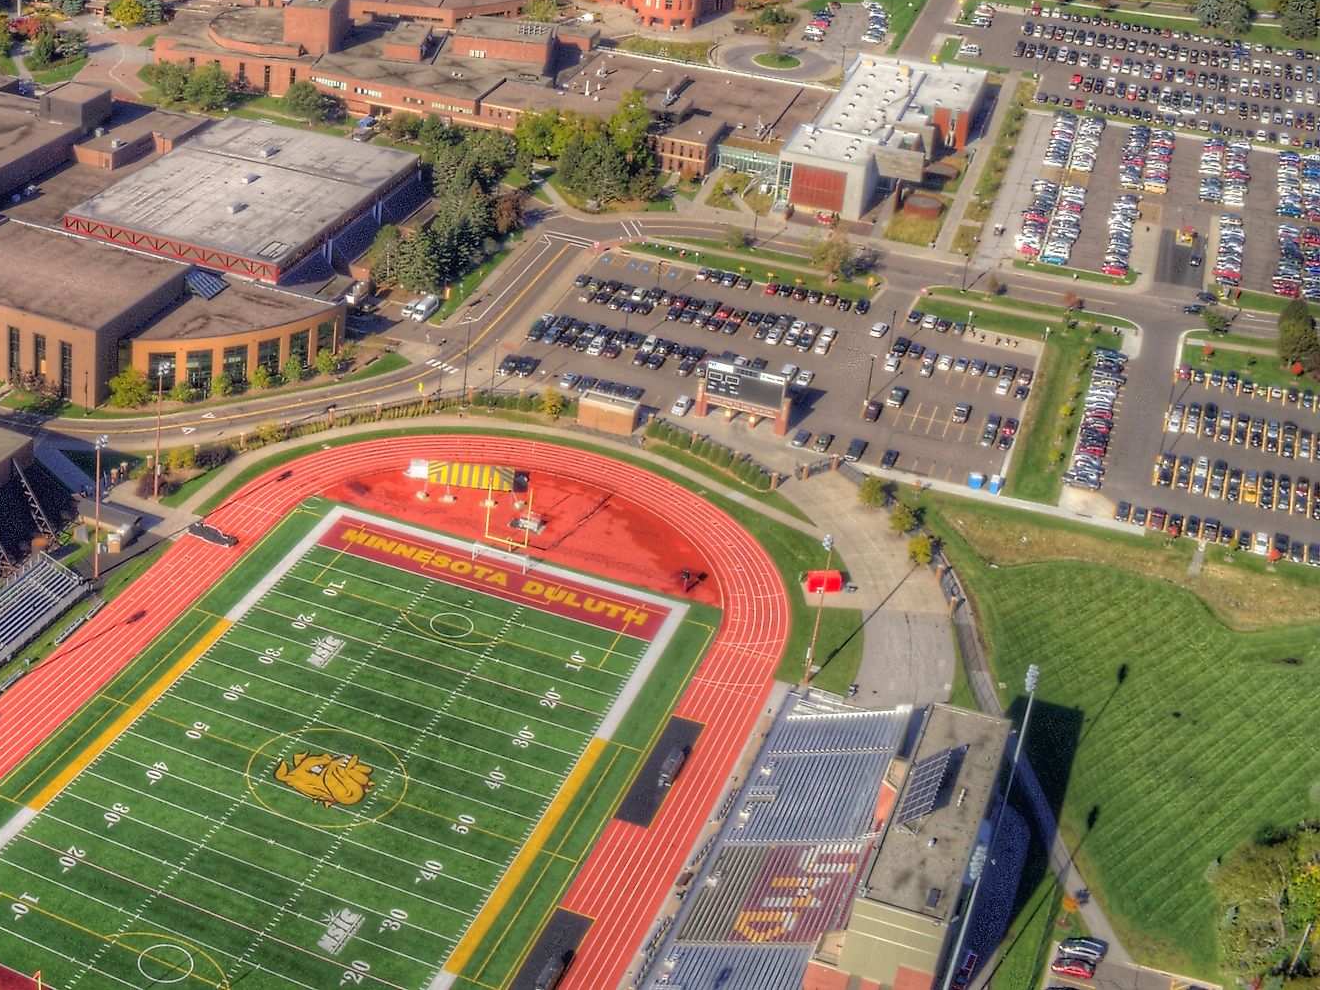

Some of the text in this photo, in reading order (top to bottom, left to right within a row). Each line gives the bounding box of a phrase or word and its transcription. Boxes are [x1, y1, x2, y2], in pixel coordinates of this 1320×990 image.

[341, 528, 649, 627] MINNESOTA DULUTH
[323, 581, 344, 596] 10
[291, 613, 314, 630] 20
[258, 648, 281, 664] 30
[565, 655, 586, 671] 10
[223, 684, 245, 701] 40
[540, 691, 561, 709] 20
[185, 721, 211, 739] 50
[512, 729, 535, 748] 30
[146, 761, 169, 780] 40
[484, 771, 506, 789] 40
[104, 802, 130, 822] 30
[451, 814, 475, 834] 50
[59, 845, 86, 867] 20
[420, 860, 443, 881] 40
[11, 892, 40, 914] 10
[382, 908, 408, 931] 30
[343, 960, 370, 984] 20
